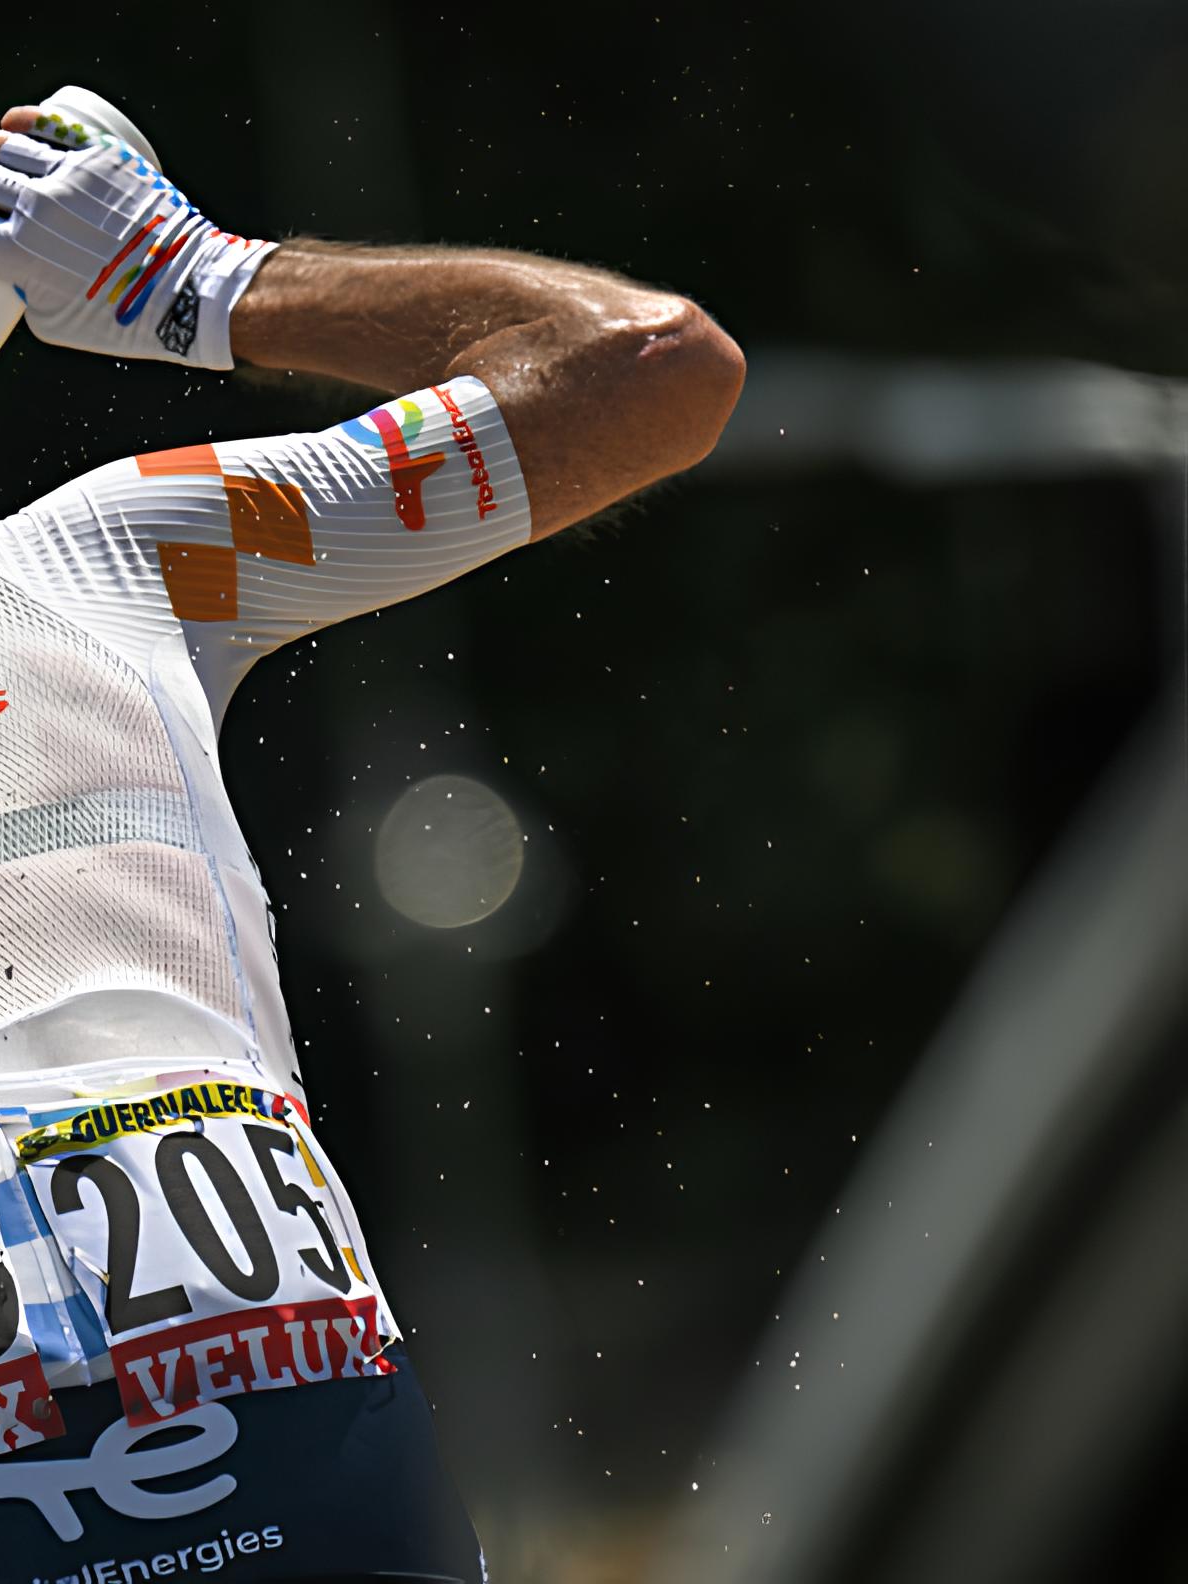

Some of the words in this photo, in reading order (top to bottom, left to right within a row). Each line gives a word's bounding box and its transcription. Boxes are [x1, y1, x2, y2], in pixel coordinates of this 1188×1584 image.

[50, 1122, 353, 1335] 205
[126, 1316, 373, 1418] VELUX
[32, 1525, 284, 1584] lEnergies
